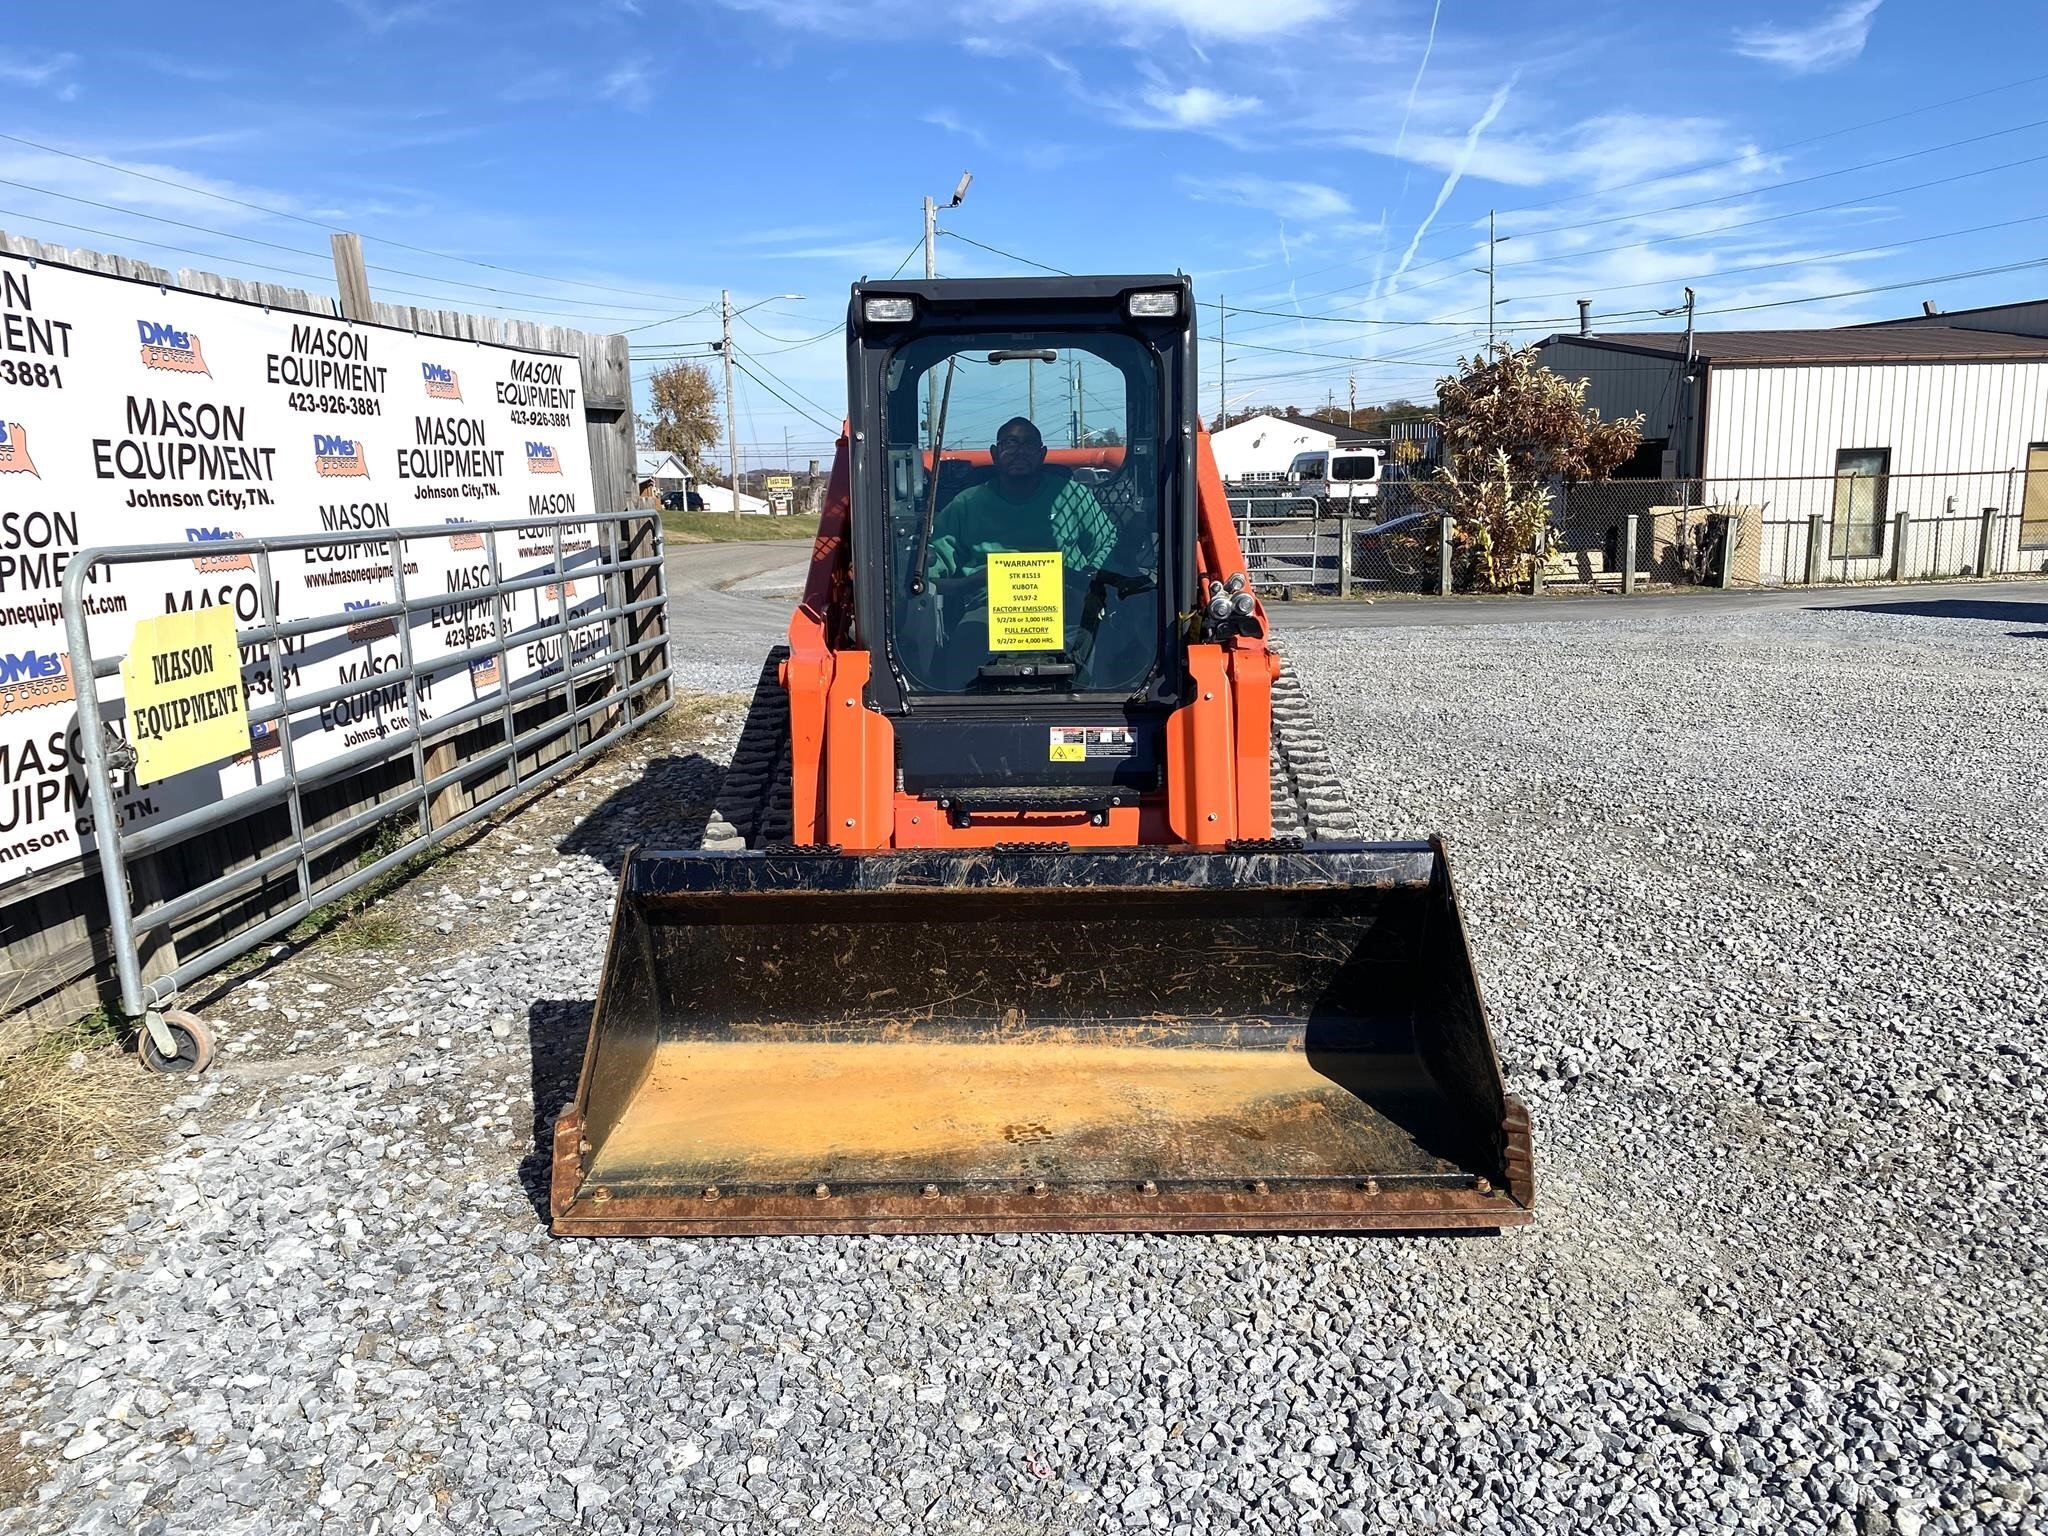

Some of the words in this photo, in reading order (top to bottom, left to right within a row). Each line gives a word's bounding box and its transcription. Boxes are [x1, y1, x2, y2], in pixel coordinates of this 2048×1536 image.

[290, 323, 368, 362] MASON
[267, 353, 388, 394] EQUIPMENT
[511, 359, 562, 386] MASON
[288, 391, 382, 417] 423-926-3881
[496, 381, 576, 410] EQUIPMENT
[126, 395, 245, 441] MASON
[415, 415, 486, 447] MASON
[510, 409, 571, 428] 423-926-3881
[92, 438, 276, 481] EQUIPMENT
[397, 448, 505, 479] EQUIPMENT
[125, 488, 204, 508] Johnson
[207, 488, 275, 510] City,TN.
[414, 484, 460, 500] Johnson
[528, 493, 575, 516] MASON
[319, 502, 391, 532] MASON
[526, 627, 602, 668] EQUIMENT
[151, 643, 214, 685] MASON
[133, 684, 239, 741] EQUIPMENT
[344, 723, 391, 748] Johnson
